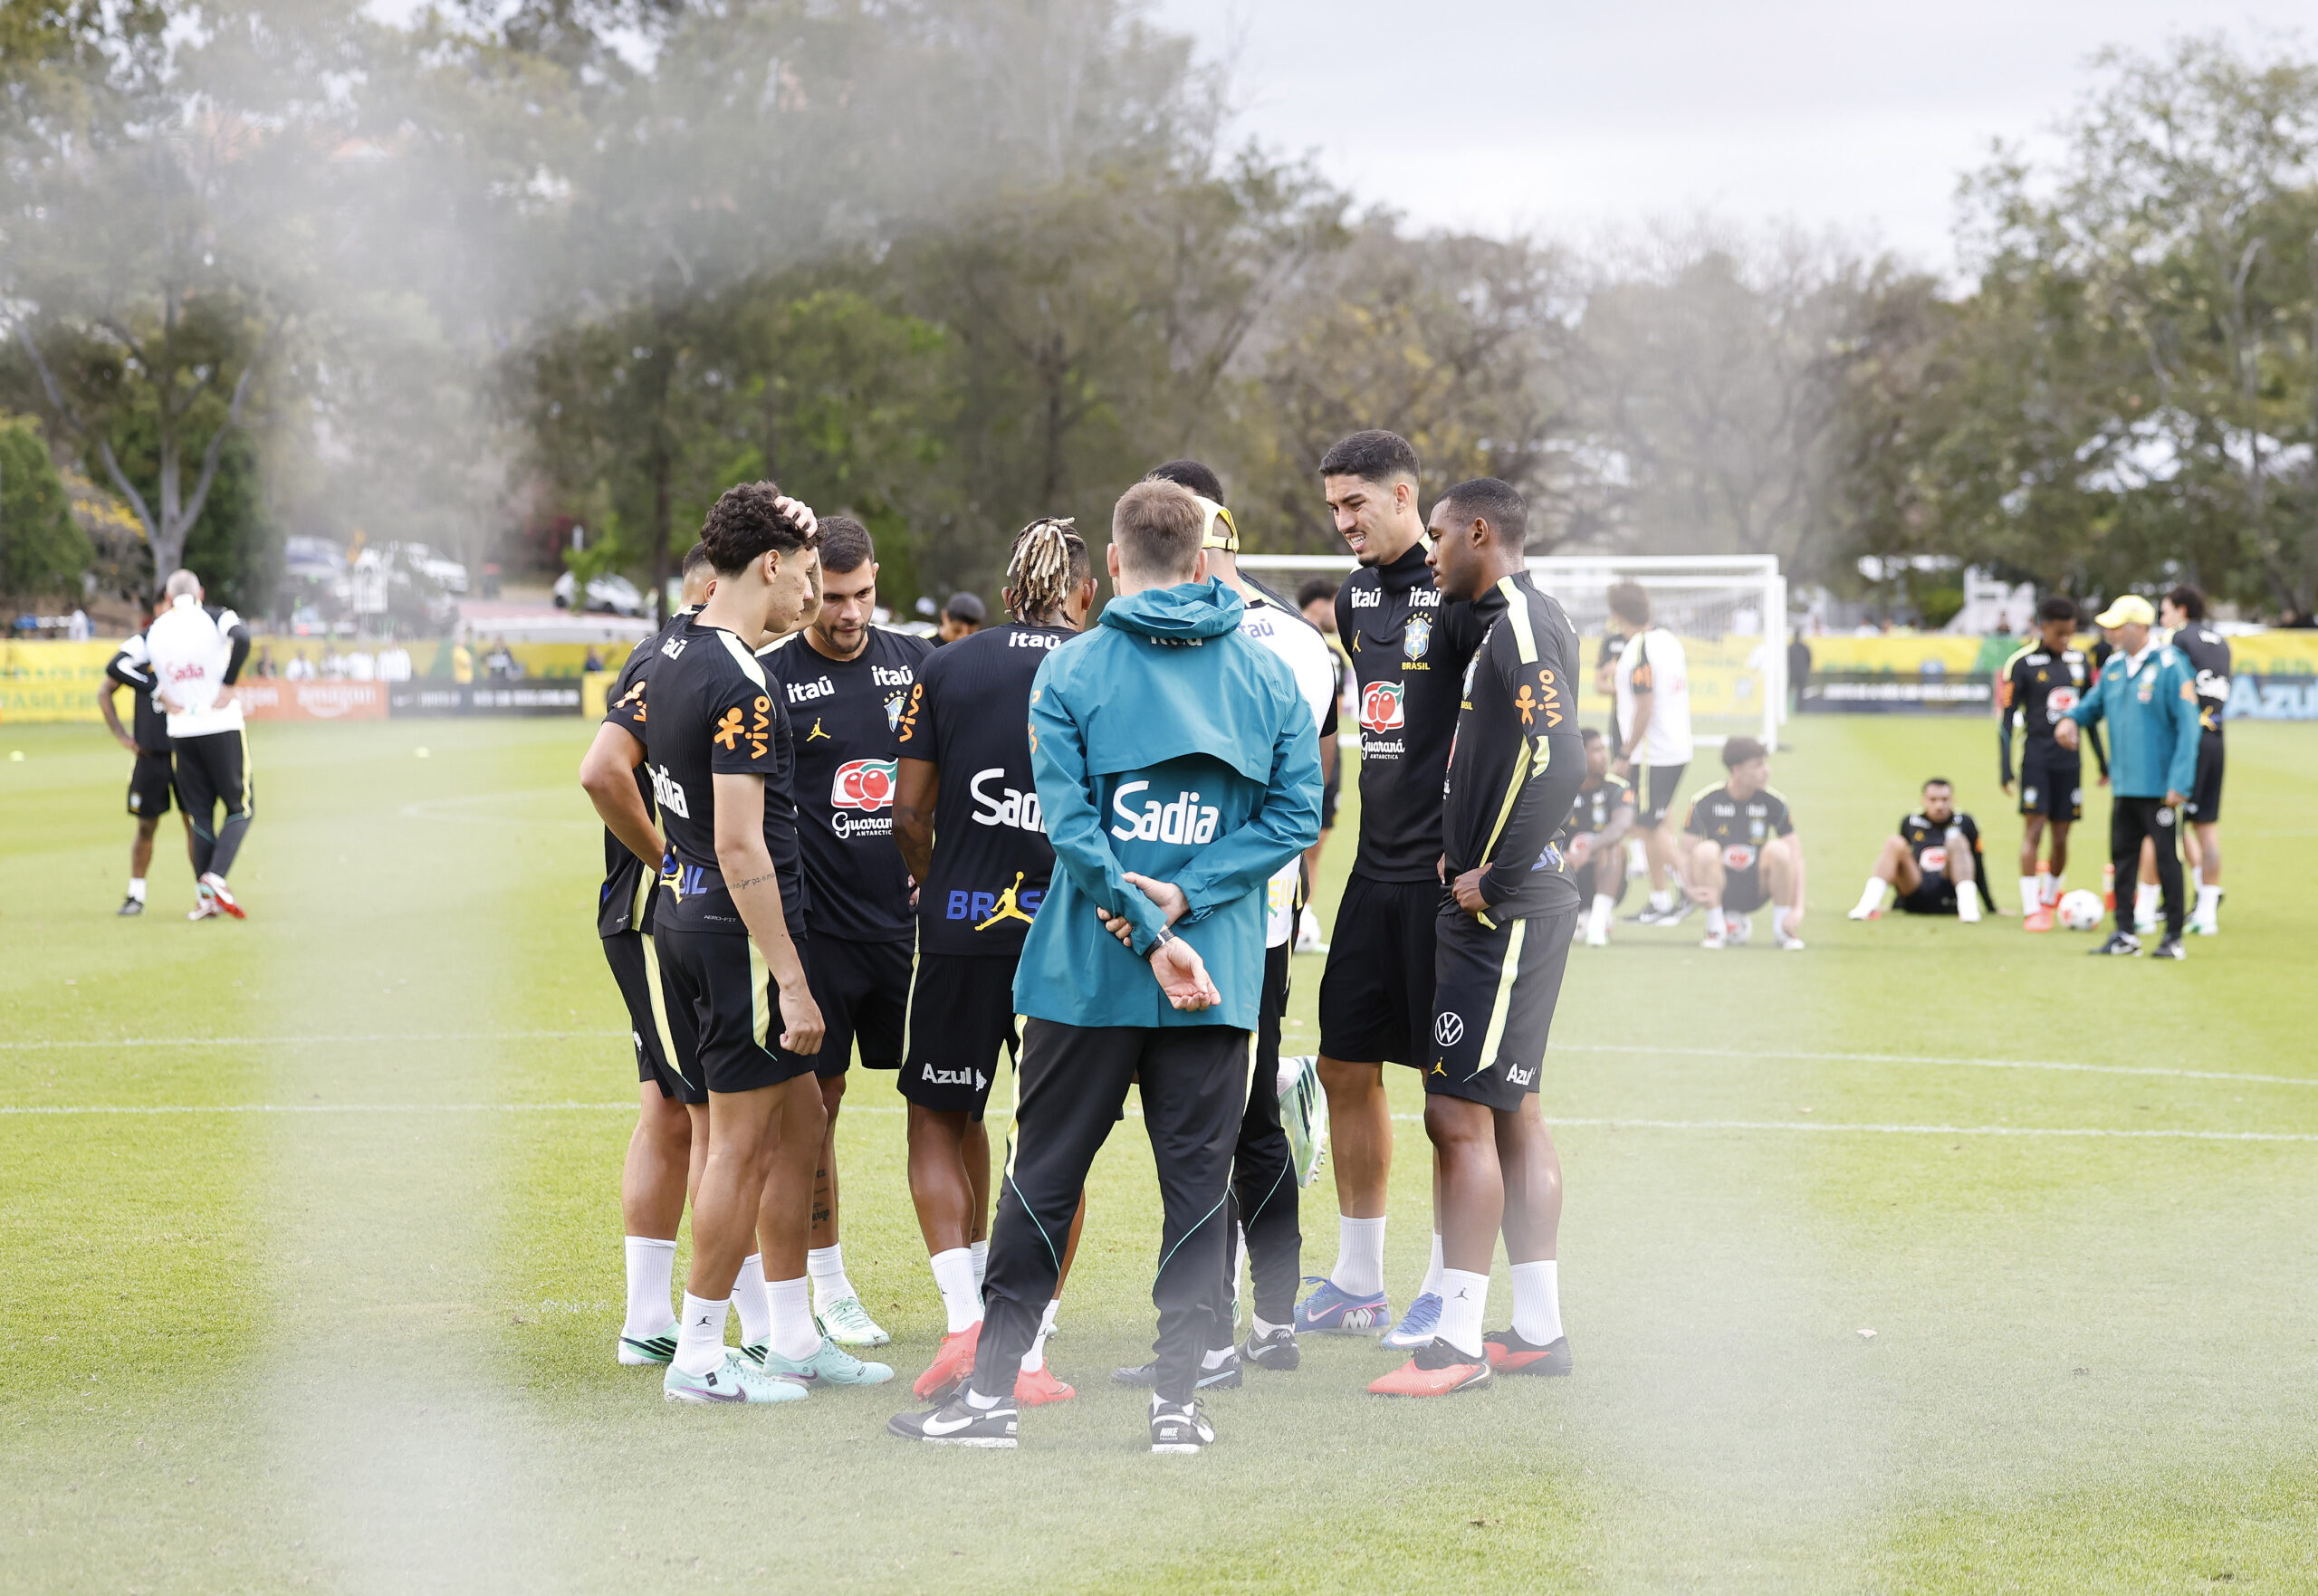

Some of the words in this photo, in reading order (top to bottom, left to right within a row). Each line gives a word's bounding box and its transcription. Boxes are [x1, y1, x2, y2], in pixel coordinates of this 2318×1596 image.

[167, 663, 205, 684] Sadia
[1402, 662, 1431, 671] BRASIL
[899, 683, 924, 742] vivo
[1538, 669, 1563, 728] vivo
[744, 695, 771, 760] vivo
[1361, 731, 1405, 760] Guaraná
[649, 764, 690, 819] adia
[1111, 780, 1219, 845] Sadia
[922, 1063, 972, 1085] Azul
[1506, 1063, 1534, 1086] Azul
[1160, 1427, 1179, 1437] NIKE
